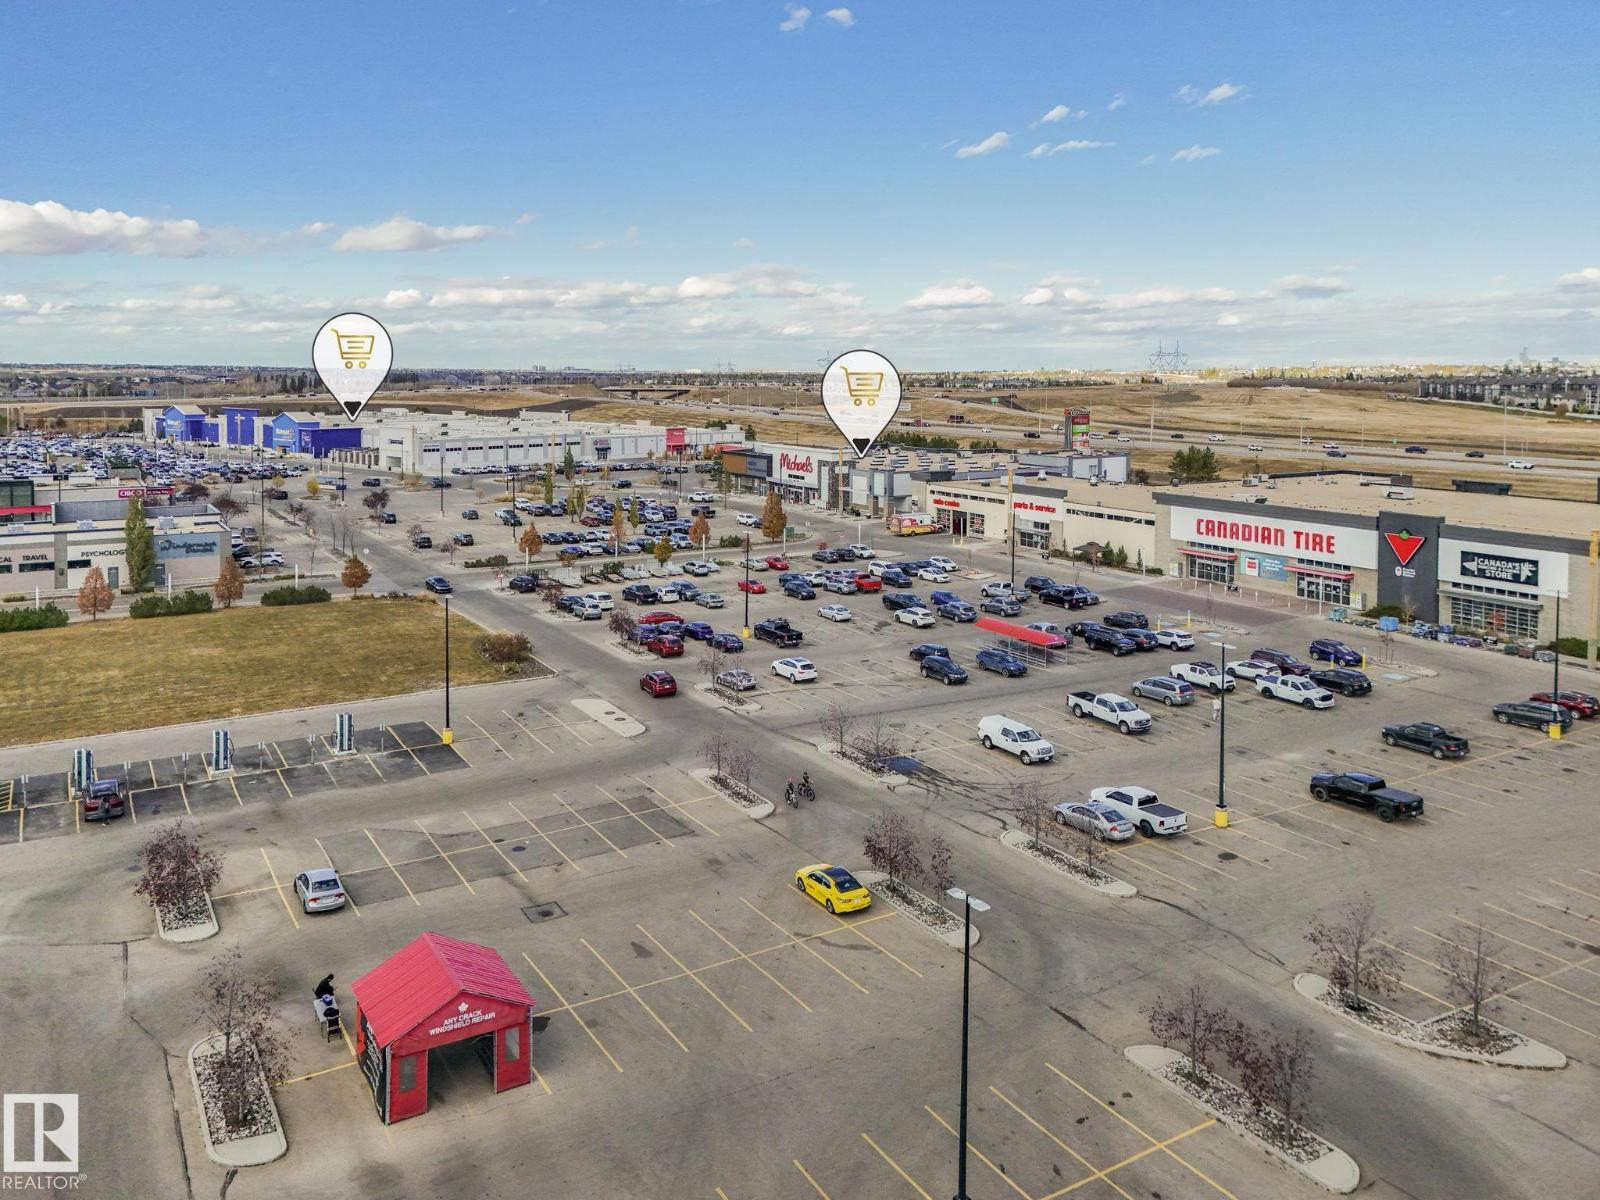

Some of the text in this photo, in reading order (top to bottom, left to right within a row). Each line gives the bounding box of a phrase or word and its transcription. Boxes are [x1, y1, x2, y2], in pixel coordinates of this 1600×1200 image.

[779, 452, 814, 474] Michaels
[1013, 501, 1057, 513] parts & service
[1196, 518, 1336, 554] CANADIAN TIRE
[1478, 558, 1521, 570] CANADA'S
[1485, 569, 1514, 580] STORE
[428, 1011, 496, 1037] WINDSHIELD REPAIR
[443, 1009, 483, 1026] ANY CRACK
